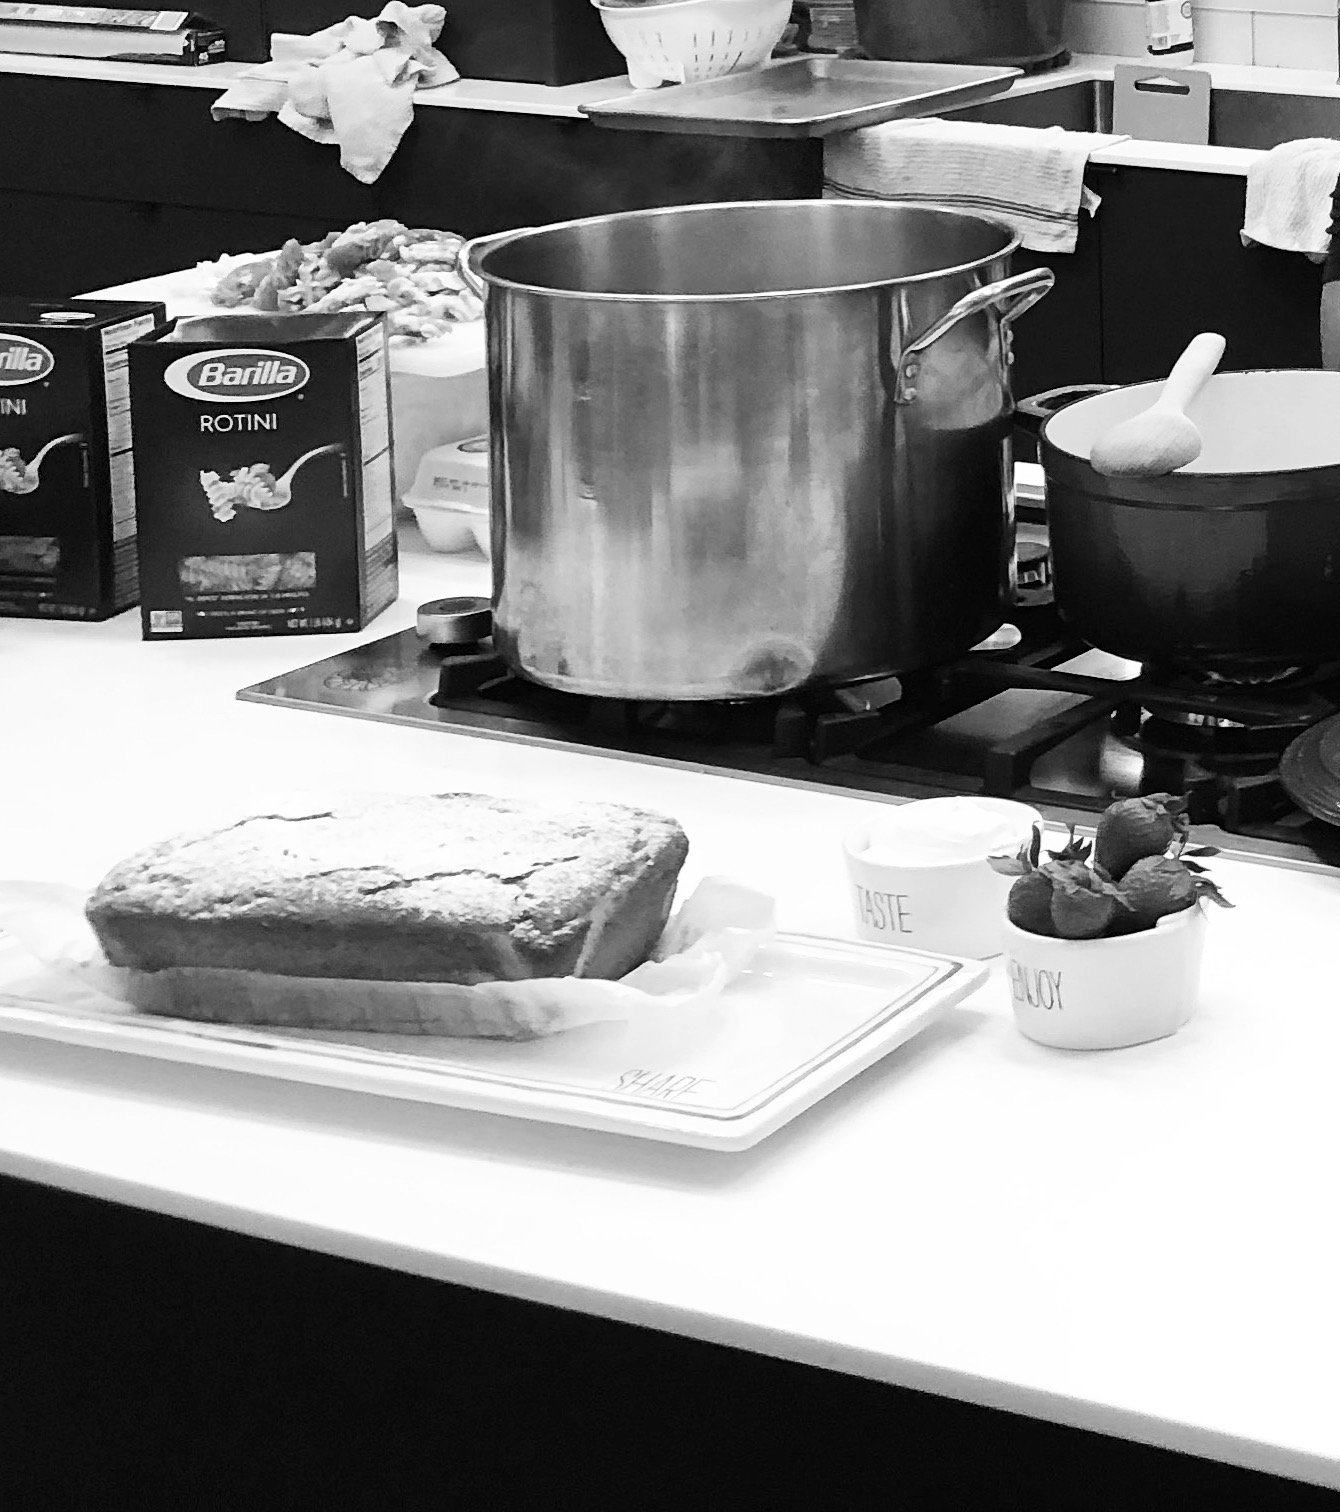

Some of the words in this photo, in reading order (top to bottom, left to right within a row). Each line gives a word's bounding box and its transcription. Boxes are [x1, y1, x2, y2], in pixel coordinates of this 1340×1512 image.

[197, 360, 298, 387] Barilla
[200, 413, 278, 432] ROTINI
[854, 883, 913, 934] TASTE
[1009, 958, 1064, 1011] ENJOY
[612, 1068, 719, 1102] SHARE
